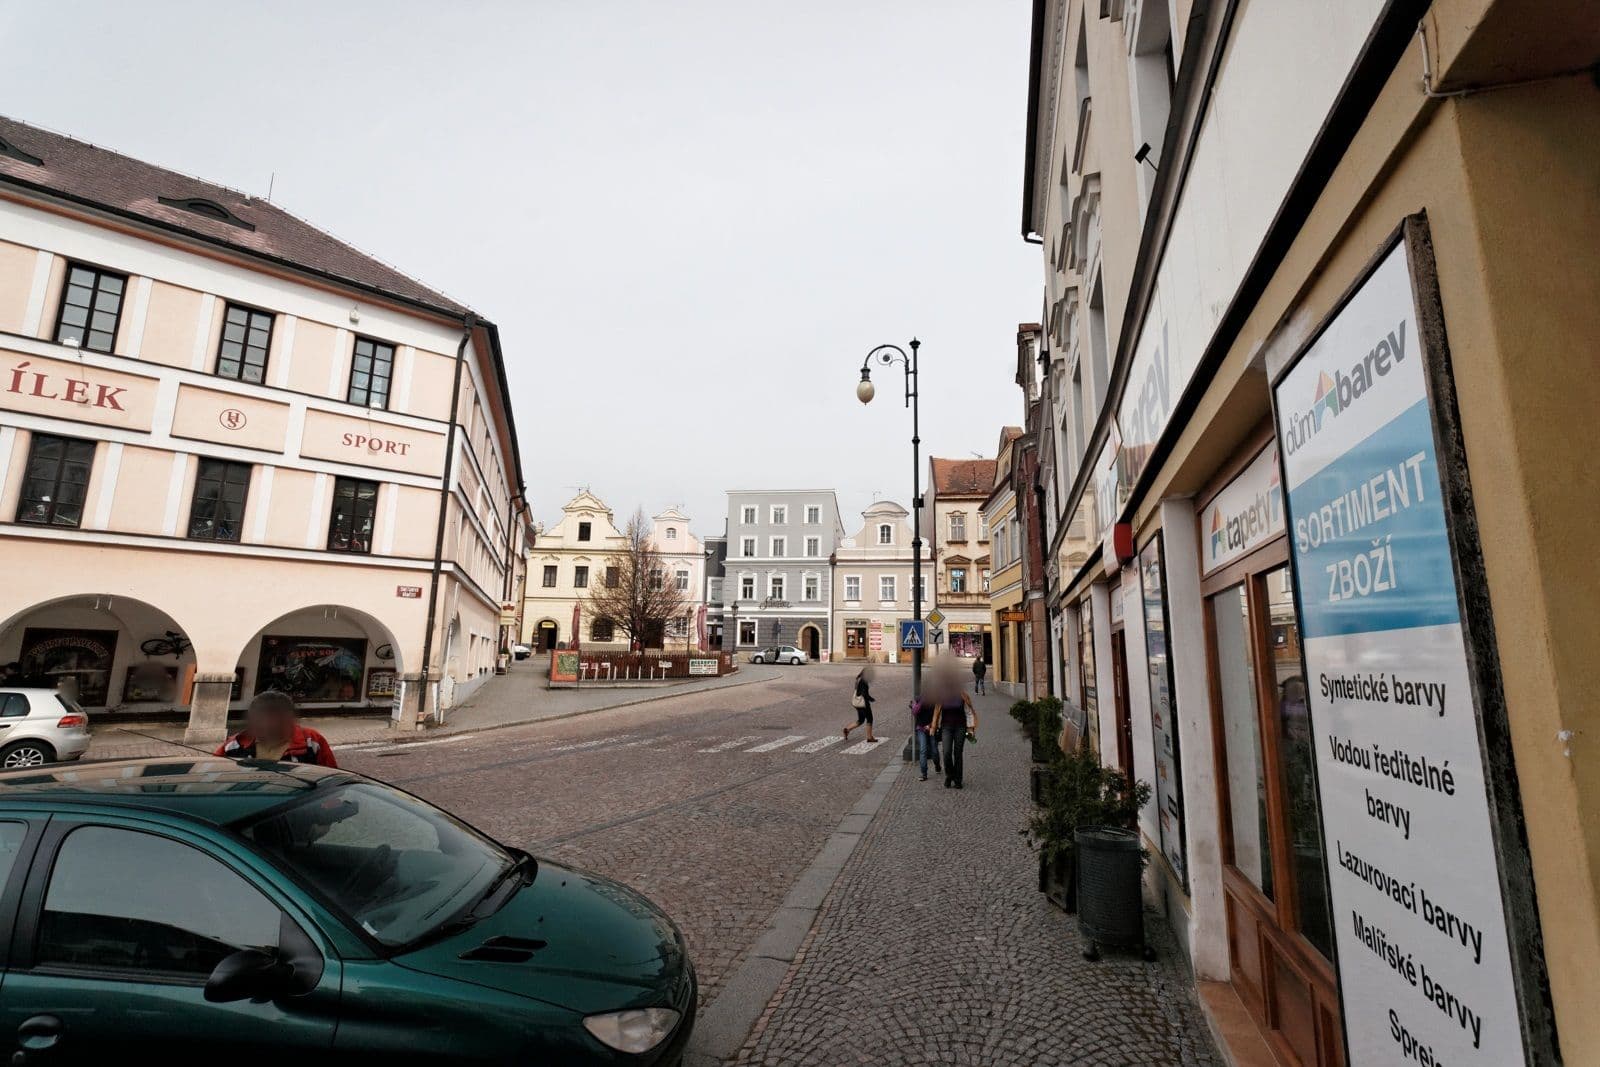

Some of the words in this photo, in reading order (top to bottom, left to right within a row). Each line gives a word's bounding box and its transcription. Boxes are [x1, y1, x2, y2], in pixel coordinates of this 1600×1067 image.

[6, 361, 128, 411] ÍLEK
[1285, 410, 1317, 456] dům
[1335, 319, 1406, 413] barev
[342, 433, 411, 455] SPORT
[1226, 490, 1270, 550] tapety
[1297, 451, 1426, 554] SORTIMENT
[1325, 533, 1397, 602] ZBOŽÍ
[1320, 672, 1389, 704] Syntetické
[1394, 673, 1446, 717] barvy
[1329, 735, 1370, 770] Vodou
[1373, 743, 1455, 796] ředitelné
[1365, 788, 1410, 840] barvy
[1336, 840, 1416, 914] Lazurovací
[1421, 889, 1483, 964] barvy
[1352, 910, 1417, 986] Malířské
[1421, 963, 1481, 1049] barvy
[1389, 1008, 1442, 1067] Spre
